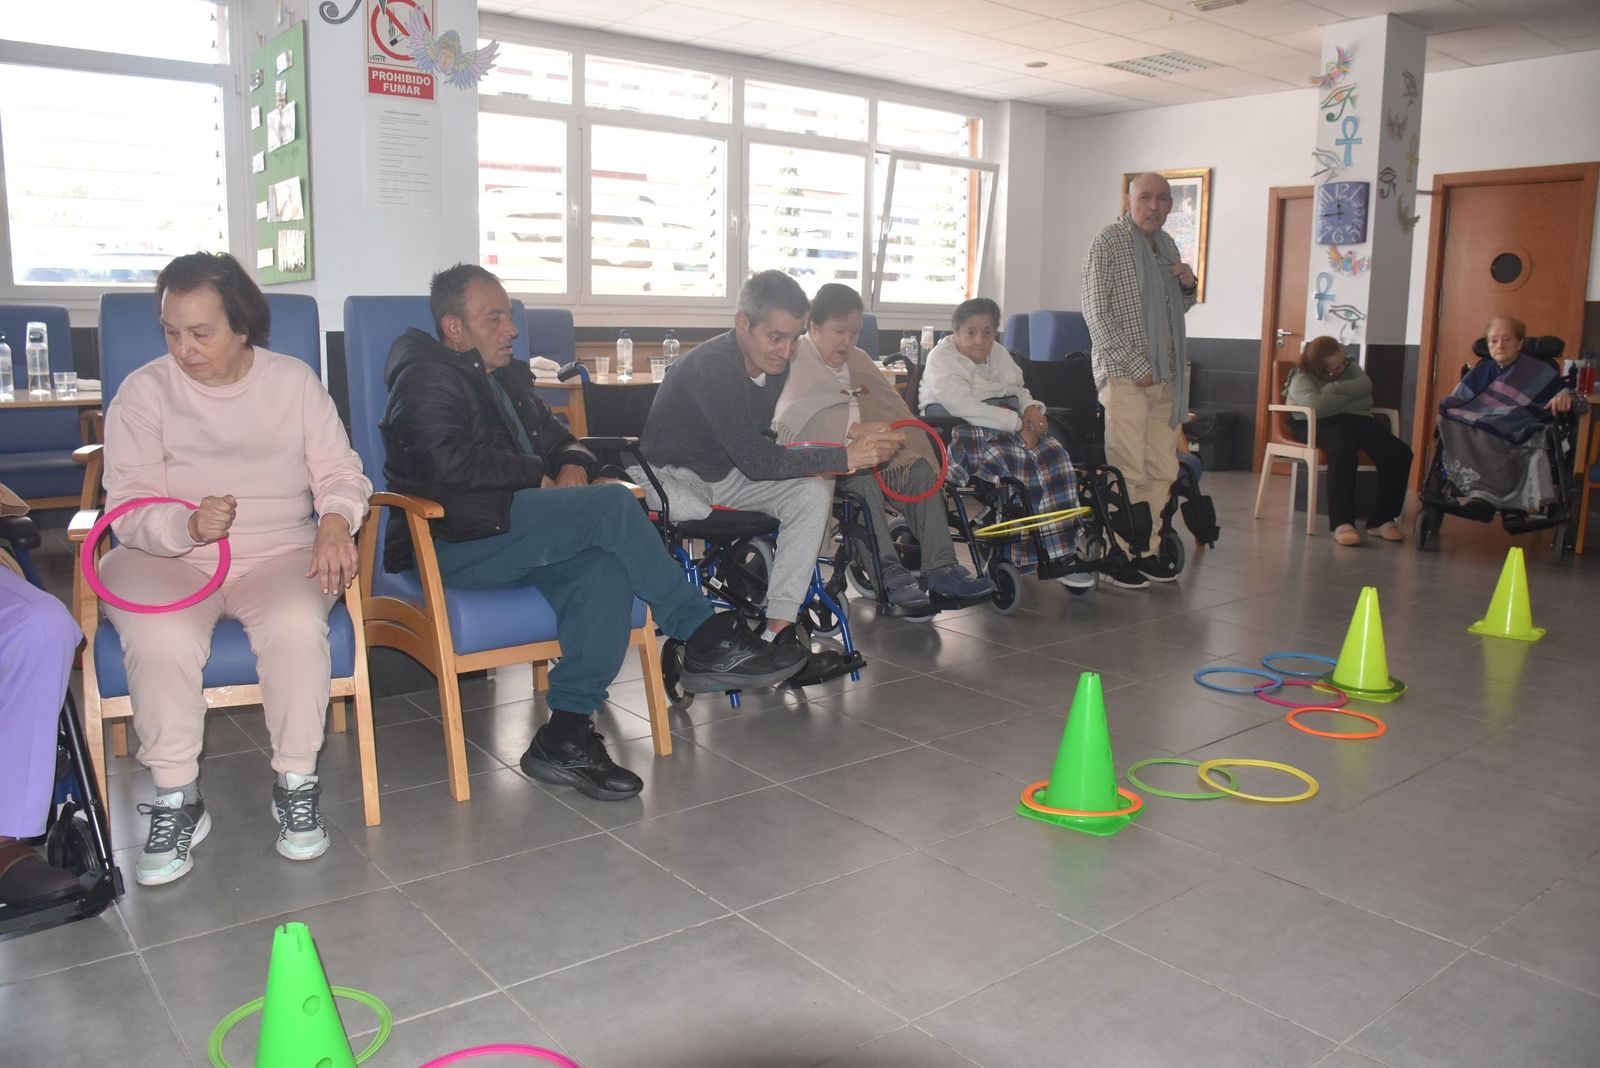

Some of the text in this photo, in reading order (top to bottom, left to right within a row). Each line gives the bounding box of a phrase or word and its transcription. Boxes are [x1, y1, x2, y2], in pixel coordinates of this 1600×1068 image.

[372, 70, 431, 86] PROHIBIDO
[383, 82, 421, 96] FUMAR
[1335, 183, 1350, 200] 12
[1331, 227, 1344, 244] 6
[1345, 224, 1361, 242] 5
